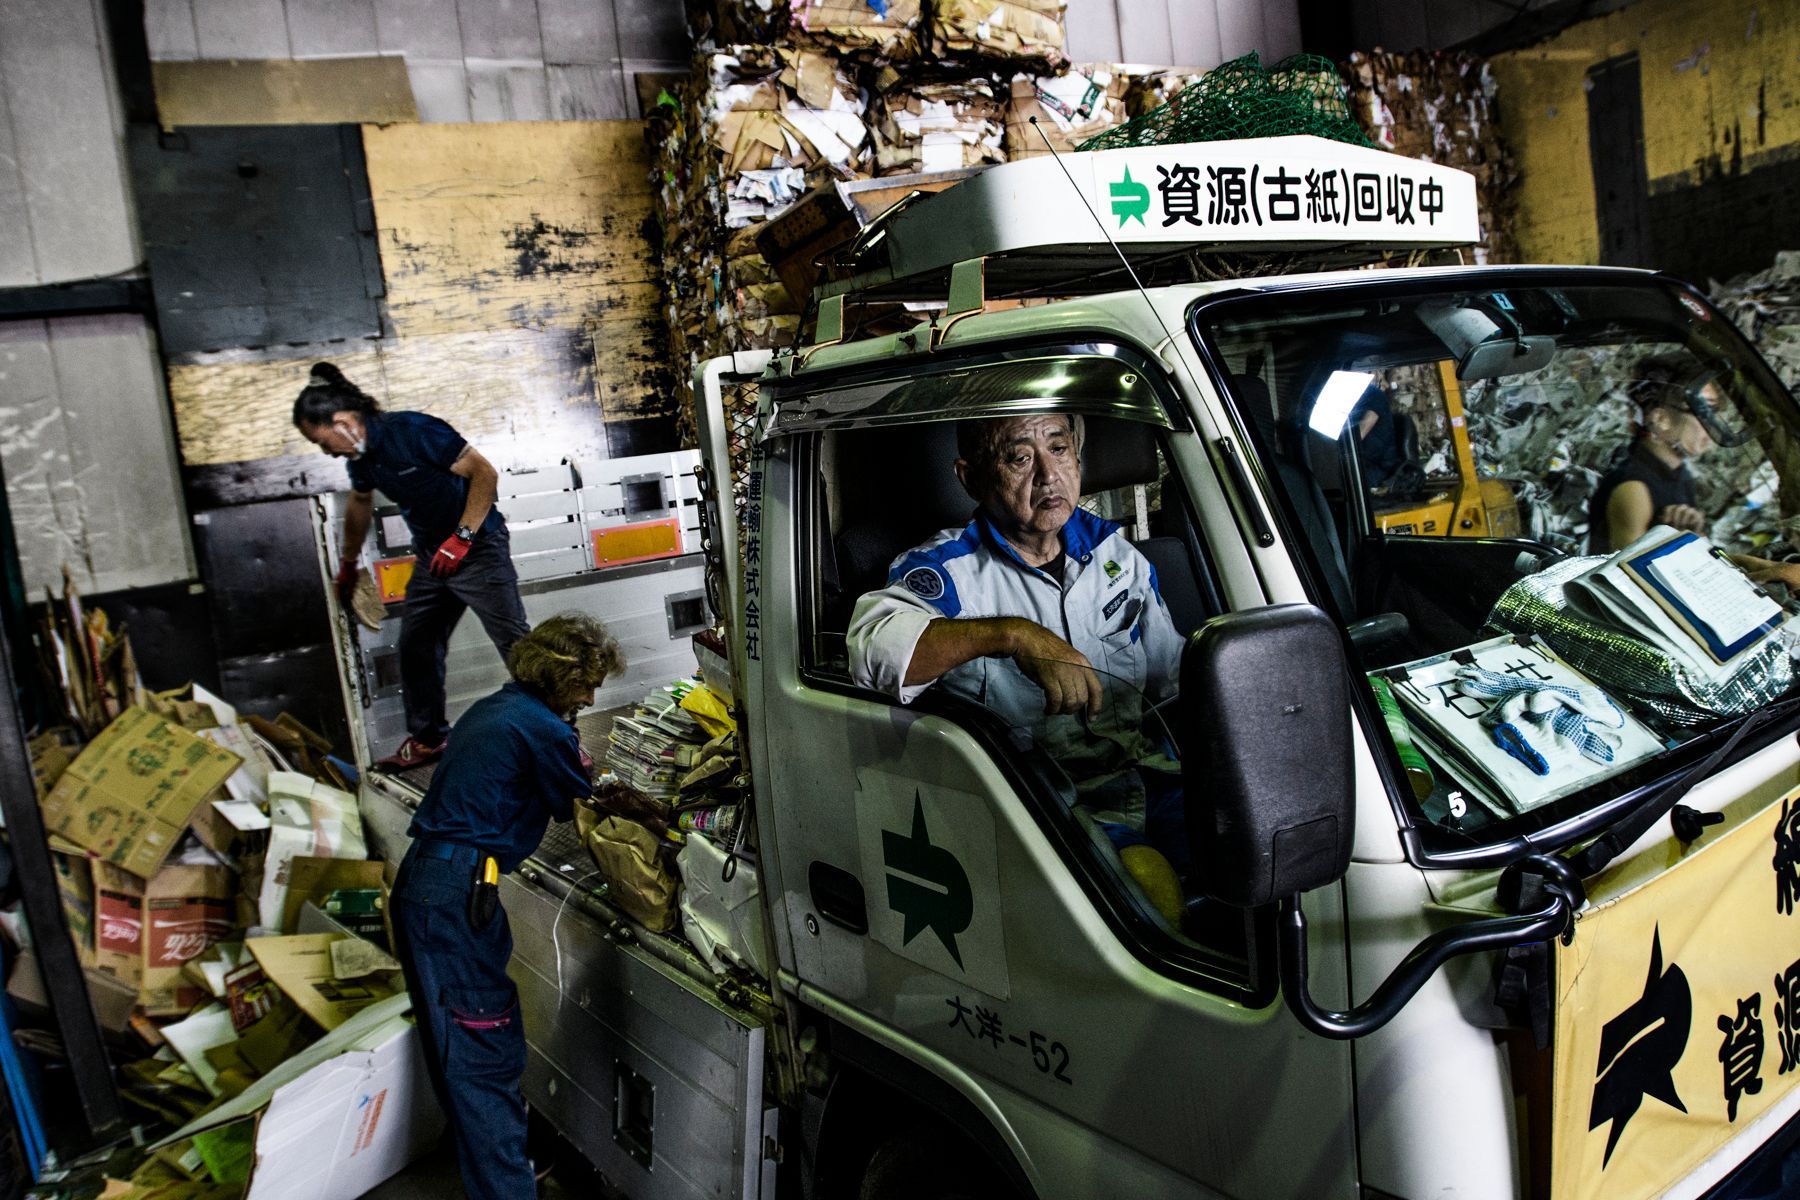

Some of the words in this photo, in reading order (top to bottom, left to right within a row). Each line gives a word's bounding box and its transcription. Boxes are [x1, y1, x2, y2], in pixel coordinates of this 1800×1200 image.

[1156, 162, 1443, 227] 資源(古紙)回収中
